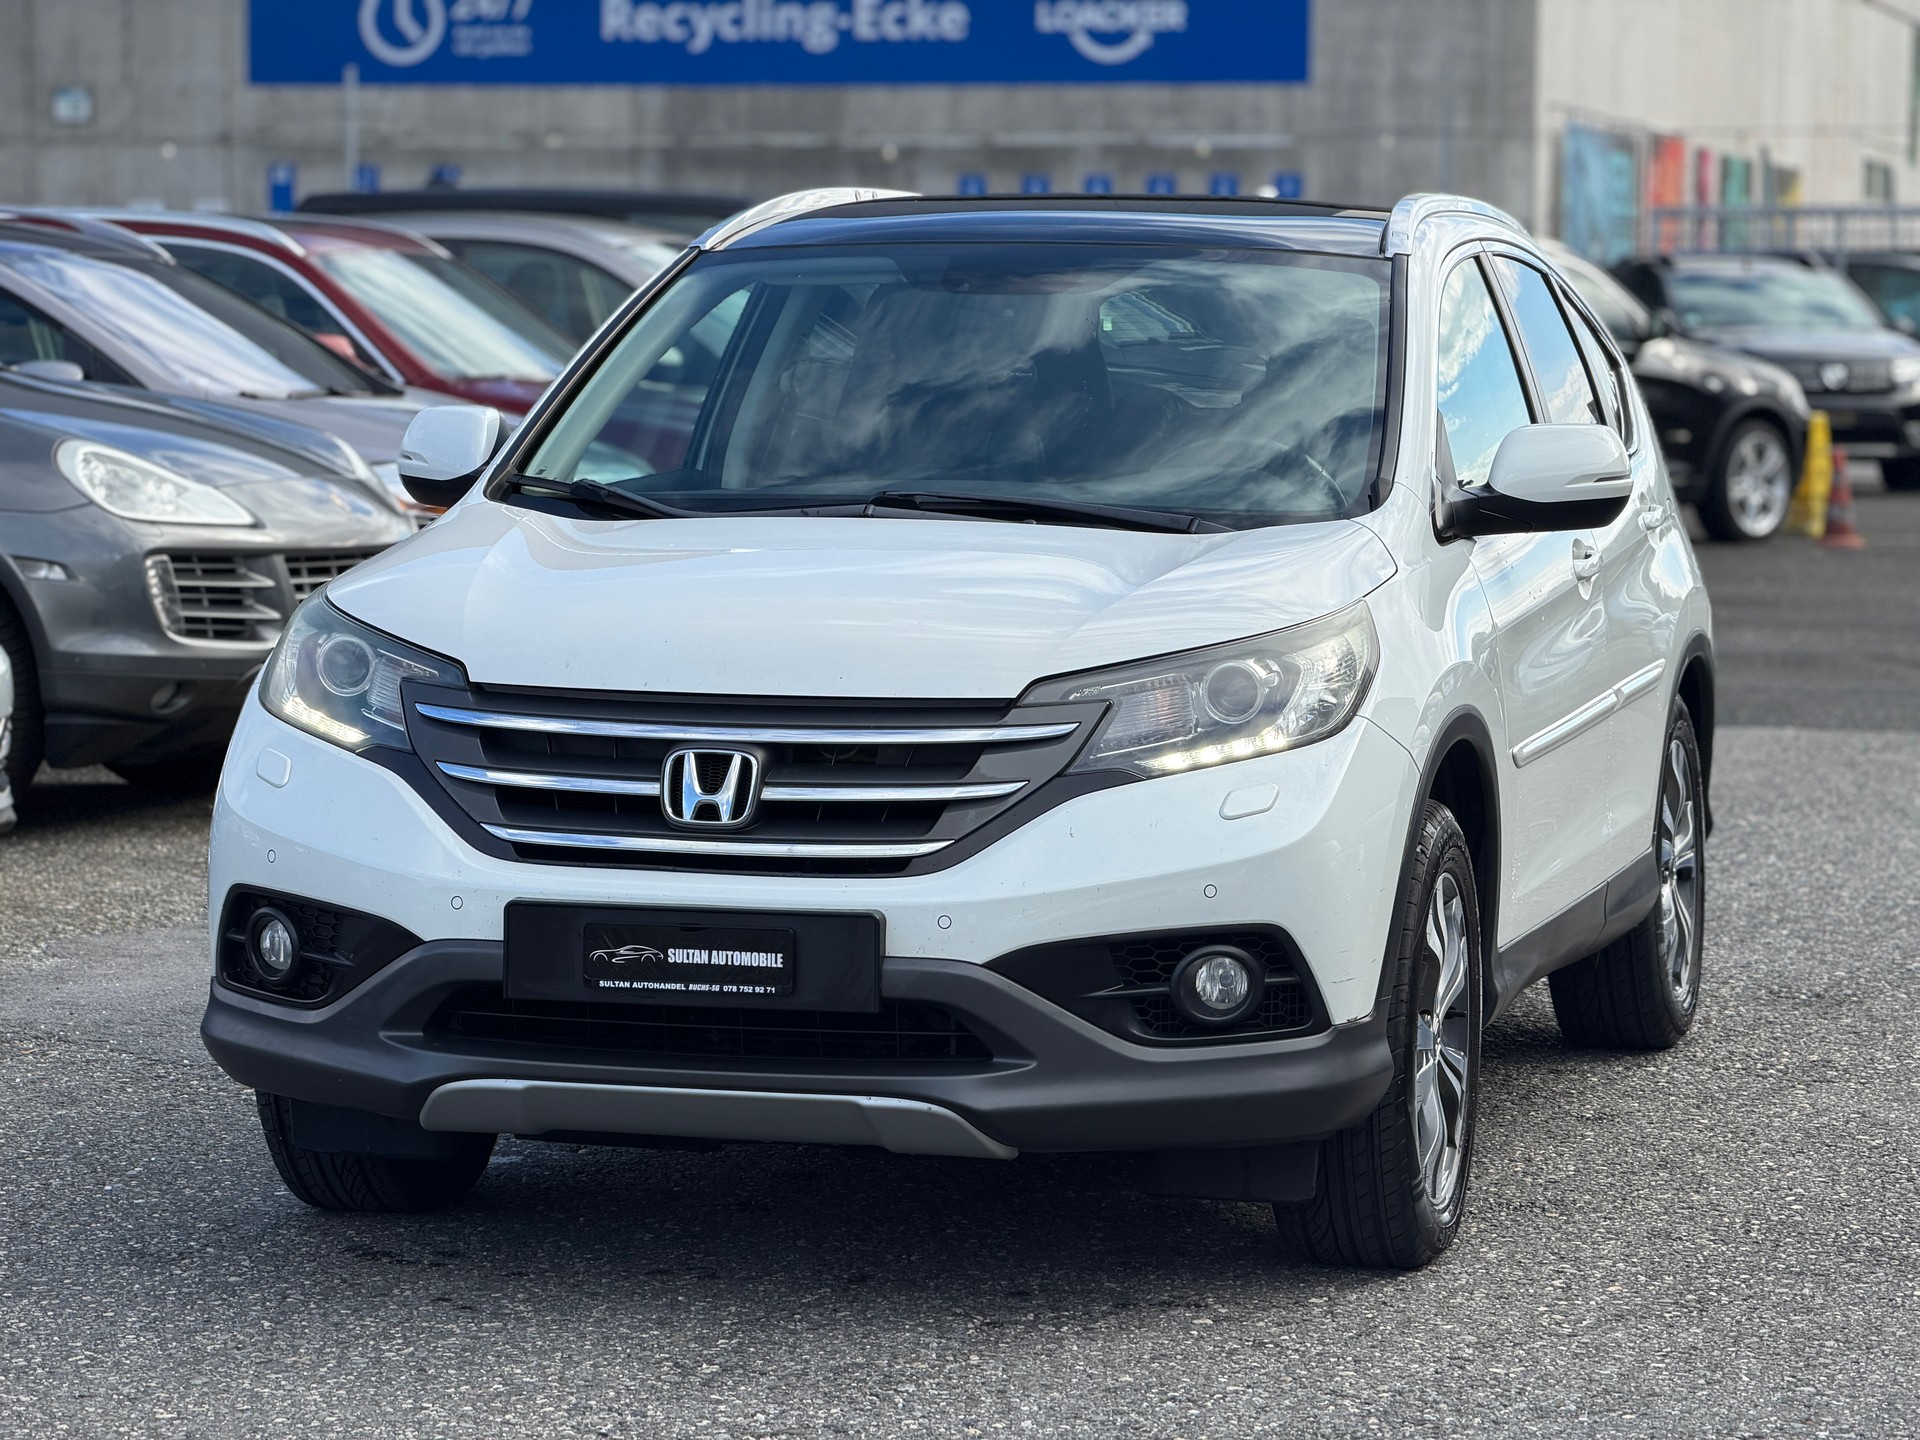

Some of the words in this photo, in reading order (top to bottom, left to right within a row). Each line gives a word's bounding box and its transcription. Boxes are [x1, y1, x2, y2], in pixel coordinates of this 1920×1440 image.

[601, 0, 970, 54] Recycling-Ecke
[667, 948, 709, 964] SULTAN
[711, 950, 784, 968] AUTOMOBILE
[599, 980, 630, 988] SULTAN
[632, 981, 686, 990] AUTOHANDEL
[688, 983, 720, 992] BUCHS-SG
[739, 985, 753, 993] 752
[766, 986, 776, 994] 71
